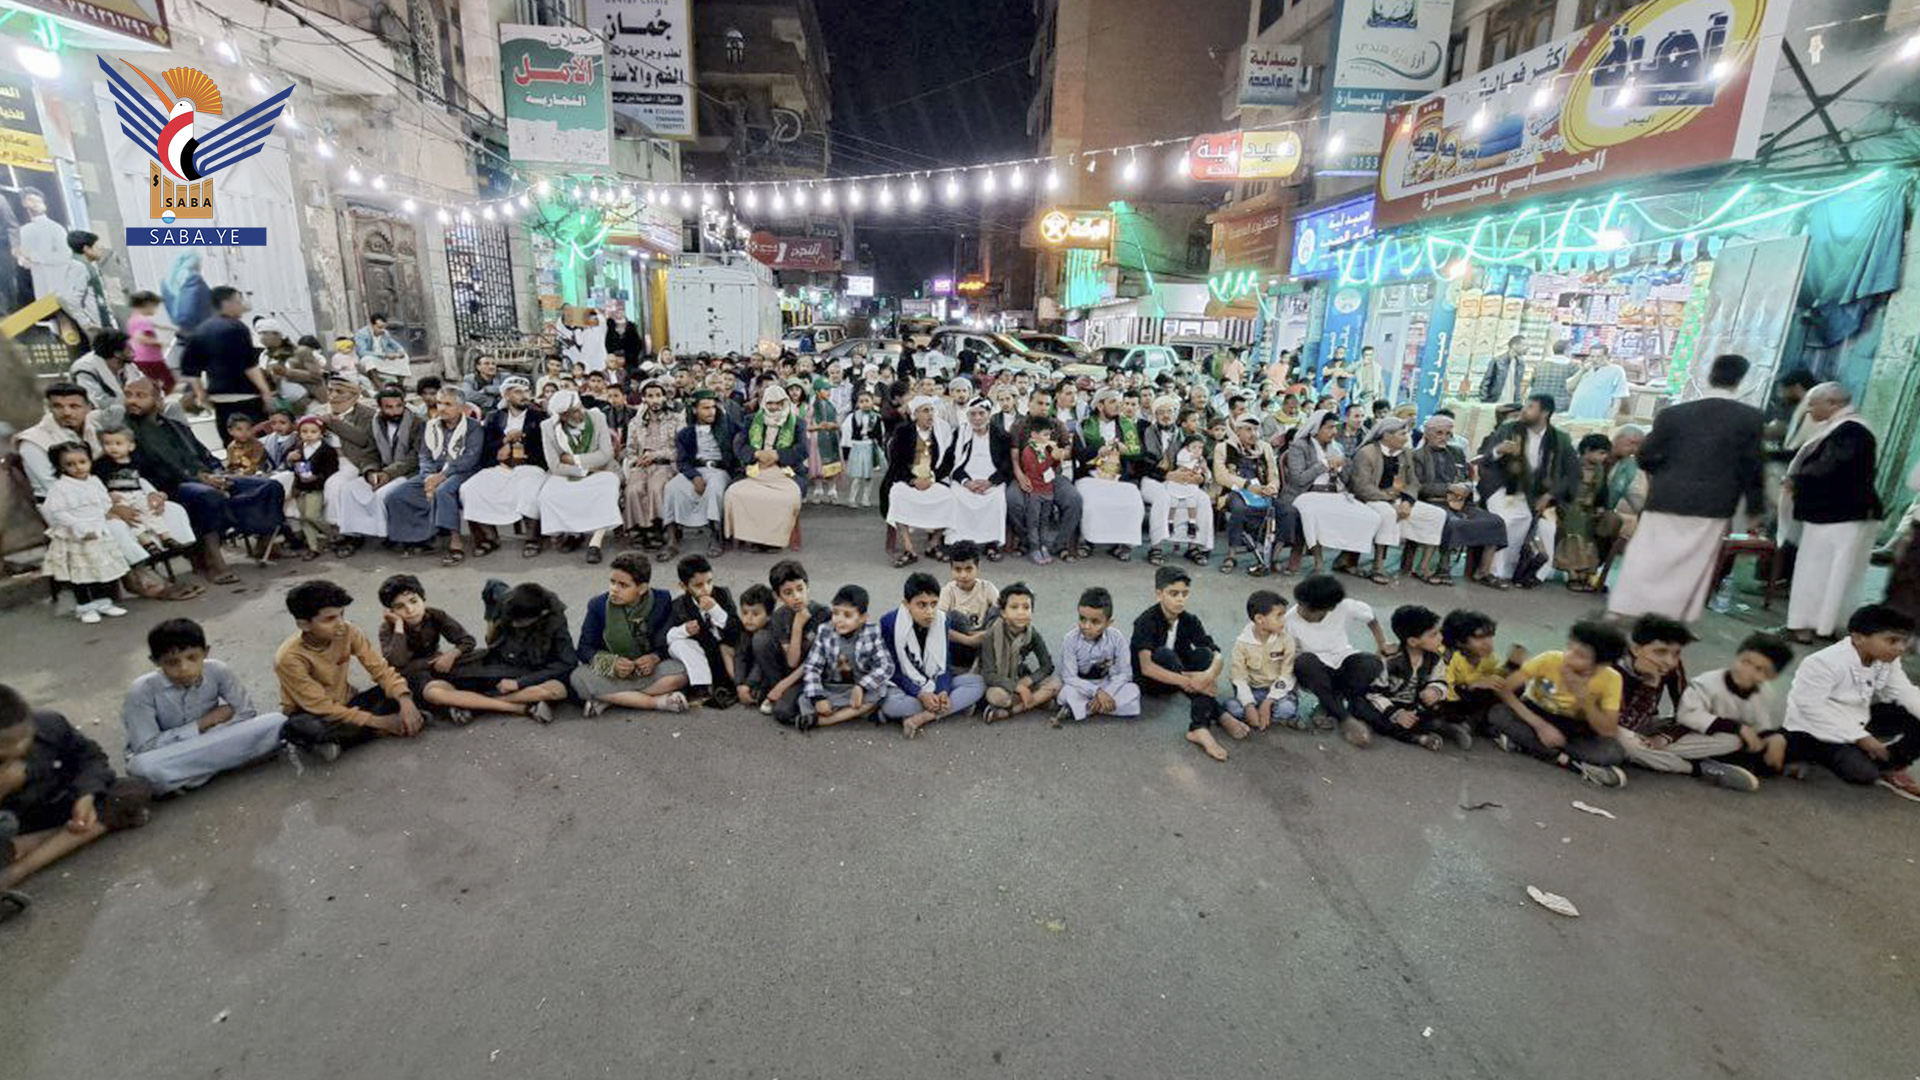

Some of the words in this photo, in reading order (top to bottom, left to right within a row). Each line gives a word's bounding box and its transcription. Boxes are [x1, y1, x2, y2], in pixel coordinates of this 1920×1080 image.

[1249, 49, 1299, 71] صيدلية
[656, 66, 684, 88] الفم
[1479, 60, 1529, 102] فعالية
[1422, 176, 1498, 211] للتجارة
[1328, 211, 1371, 232] صيدلية
